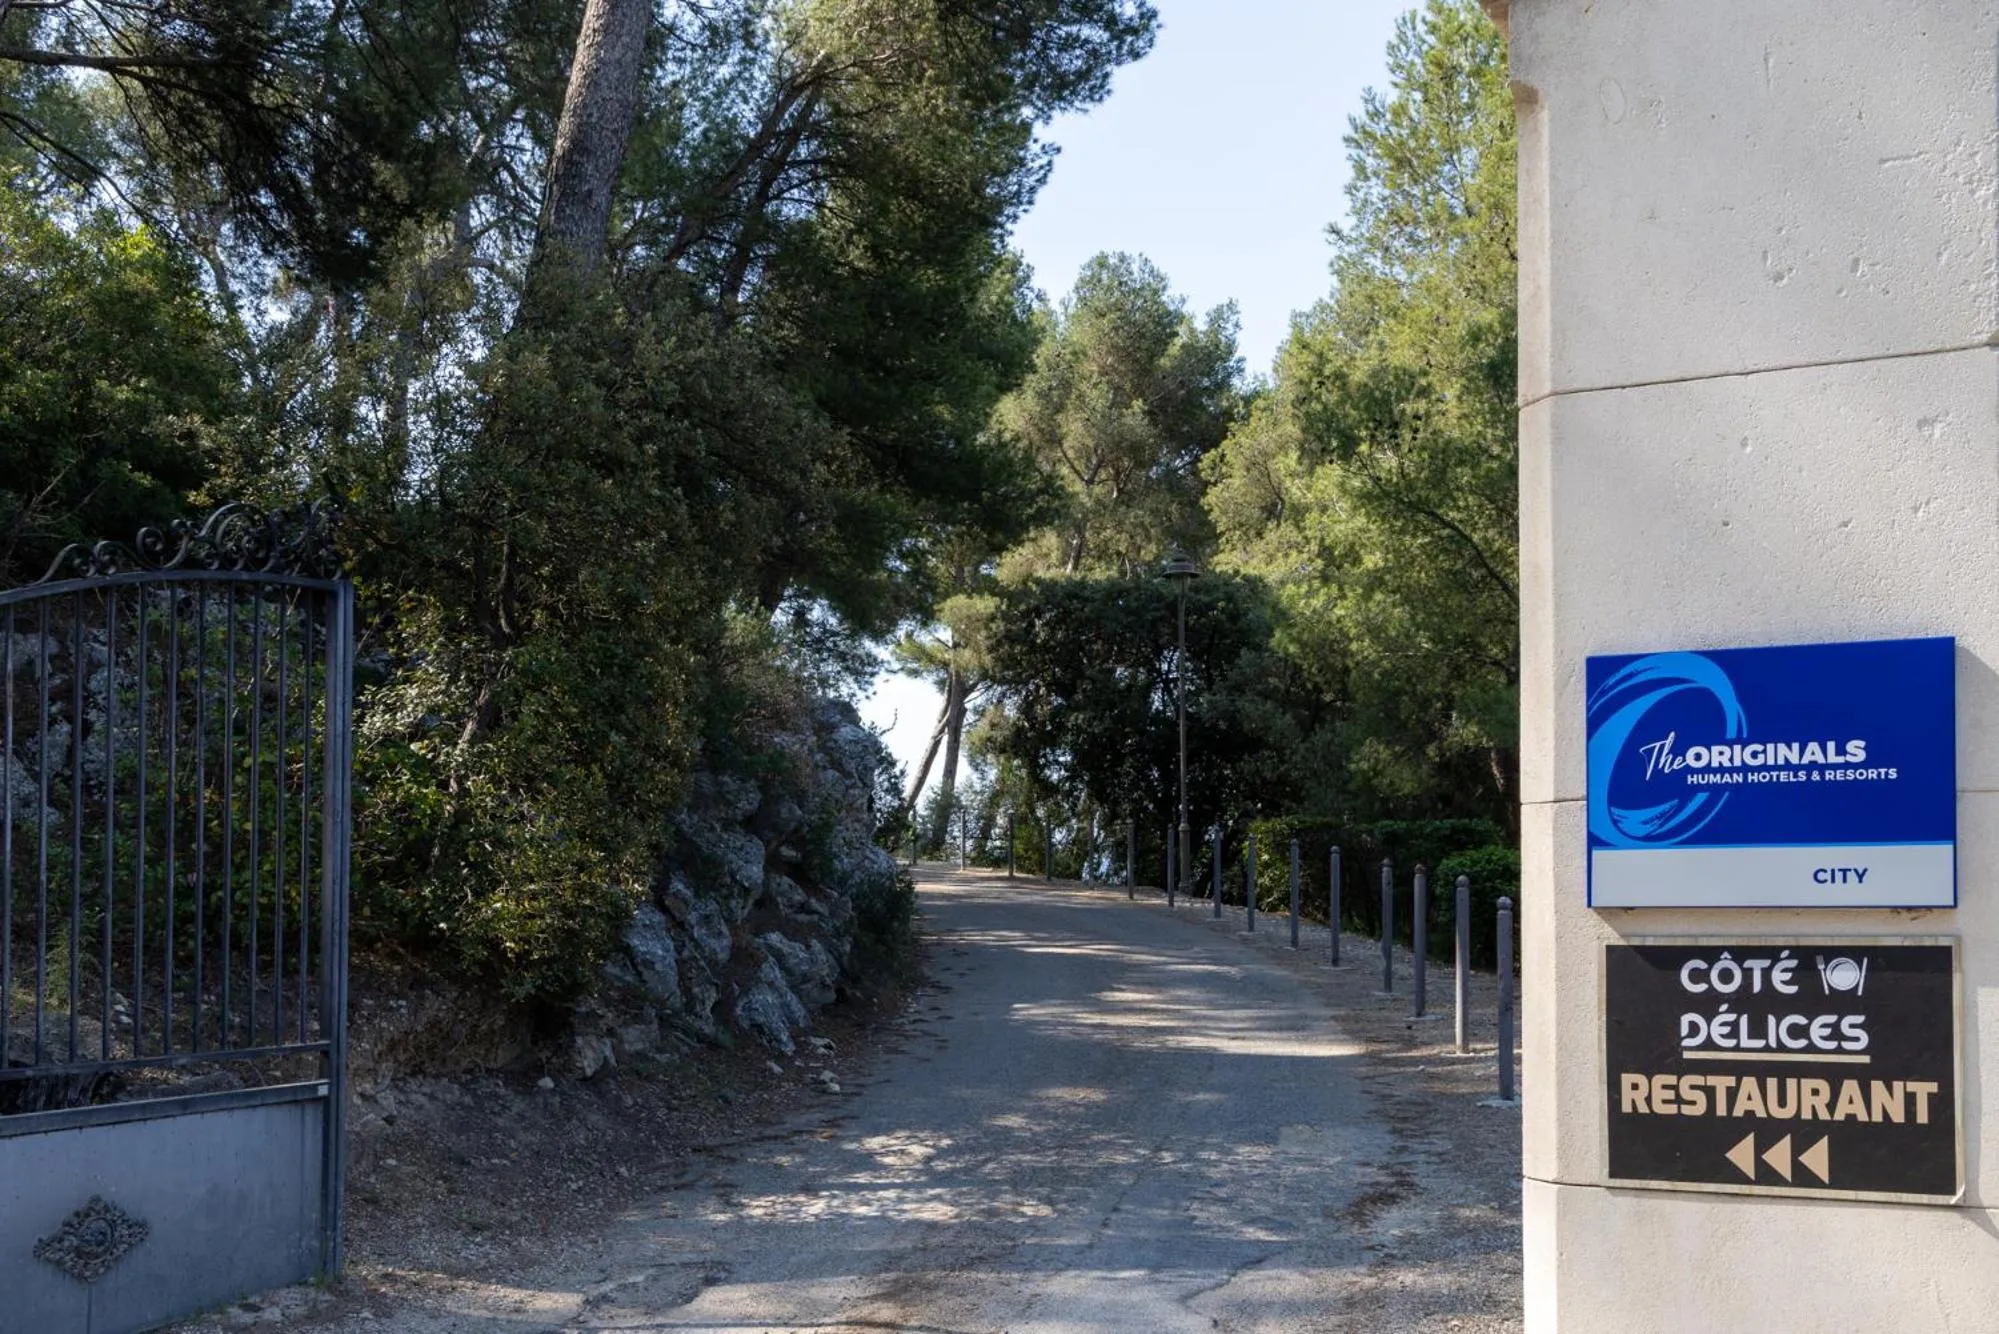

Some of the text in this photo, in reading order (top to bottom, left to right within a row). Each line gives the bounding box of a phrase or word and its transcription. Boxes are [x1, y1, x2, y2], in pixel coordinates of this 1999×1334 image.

[1687, 768, 1898, 785] HUMAN HOTELS & RESORTS
[1812, 867, 1869, 885] CITY
[1680, 949, 1799, 994] CÔTÉ
[1680, 1003, 1870, 1051] DÉLICES
[1621, 1072, 1938, 1124] RESTAURANT
